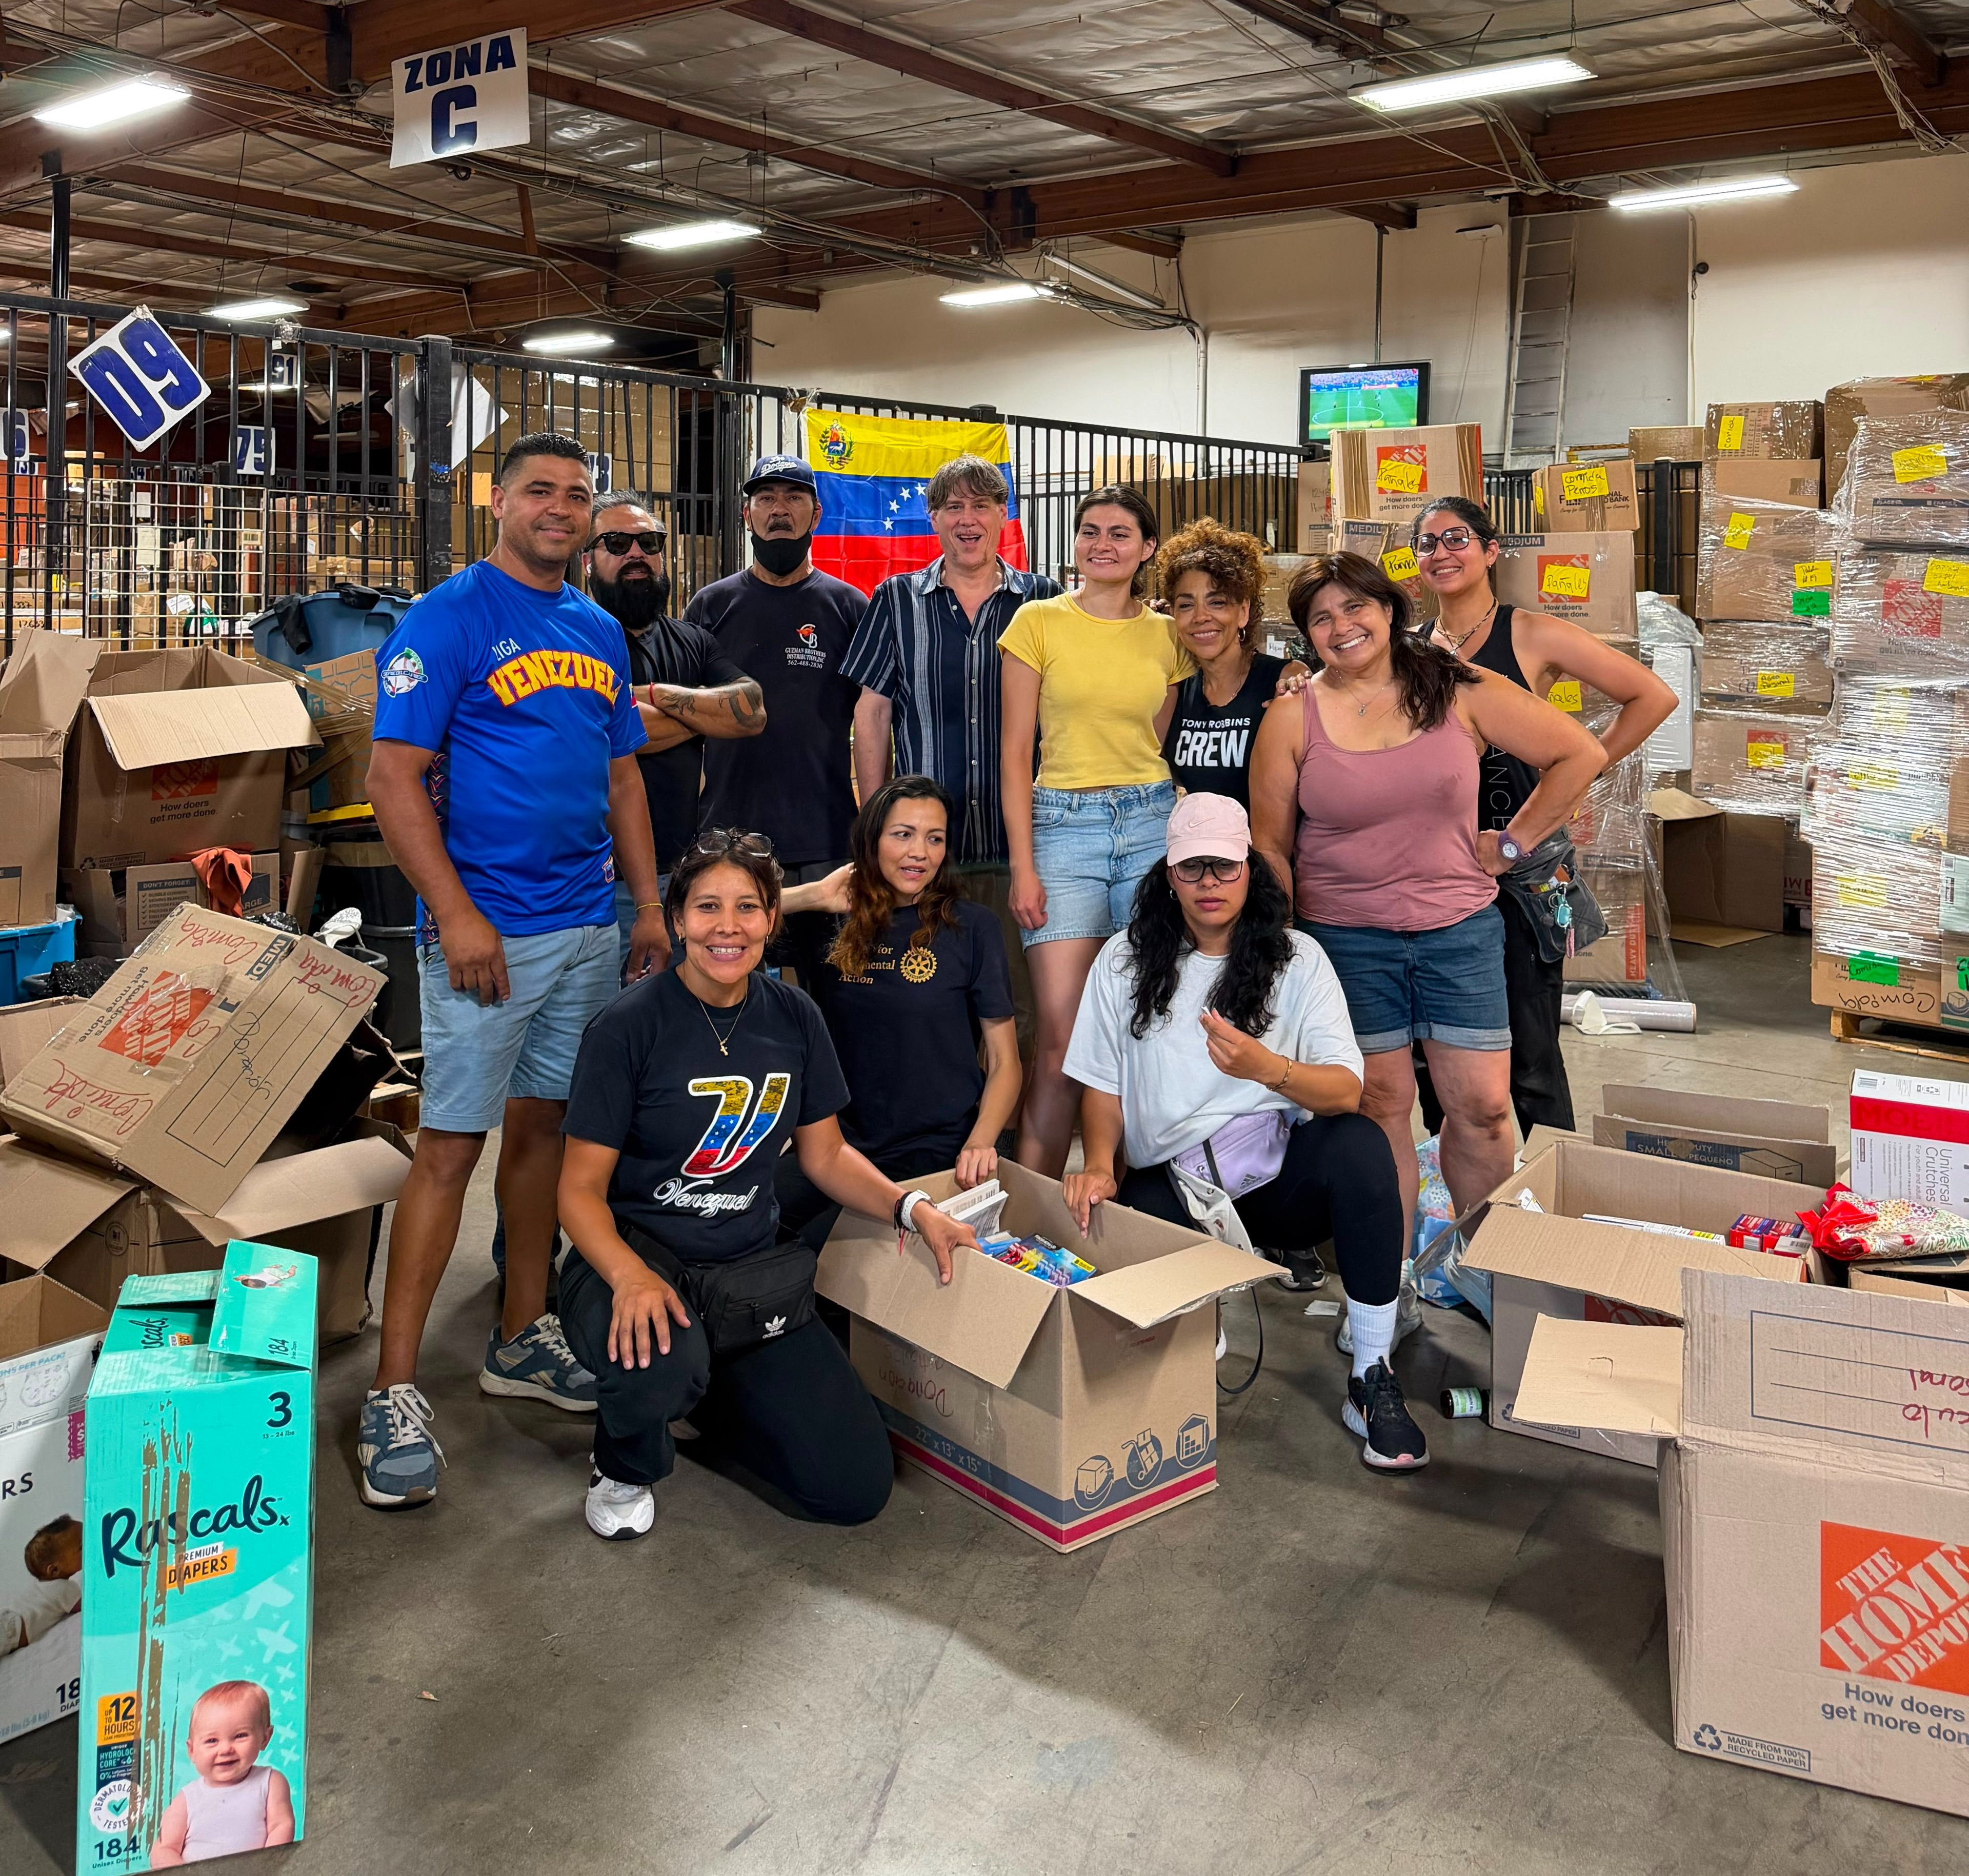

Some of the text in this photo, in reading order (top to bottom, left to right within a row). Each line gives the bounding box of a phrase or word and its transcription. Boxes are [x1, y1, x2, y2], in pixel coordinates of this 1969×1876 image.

[404, 36, 516, 94] ZONA
[431, 85, 478, 155] C
[82, 317, 202, 442] 09
[761, 461, 798, 474] Dodgers
[805, 648, 826, 658] BROTHERS
[487, 650, 622, 708] VENEZUEL
[1182, 718, 1251, 729] TONY ROBBINS
[1174, 730, 1250, 768] CREW
[149, 813, 166, 824] get
[168, 806, 192, 820] more
[160, 800, 210, 812] How doers
[877, 943, 894, 955] for
[130, 966, 149, 986] get
[838, 974, 874, 984] Action
[94, 979, 149, 1037] How doers
[105, 985, 132, 1014] more
[1838, 992, 1935, 1013] Comida
[1689, 1153, 1734, 1166] PEQUEÑO
[1695, 1144, 1712, 1153] UTY
[1925, 1146, 1939, 1202] Crutches
[1940, 1148, 1953, 1206] Universal
[268, 1337, 289, 1356] 184
[266, 1391, 292, 1428] 3
[178, 1545, 219, 1563] PREMIUM
[168, 1555, 228, 1584] DIAPERS
[1835, 1546, 1903, 1601] THE
[60, 1699, 81, 1713] DIAP
[104, 1708, 112, 1717] UP
[109, 1696, 135, 1722] 12
[1844, 1682, 1965, 1723] How doers
[104, 1721, 135, 1736] HOURS
[1820, 1703, 1969, 1745] get more don
[99, 1748, 135, 1761] HYDROLOC
[1727, 1736, 1806, 1760] MADE FROM 100%
[1727, 1743, 1806, 1768] RECYCLED PAPER
[94, 1834, 140, 1861] 184
[92, 1860, 114, 1869] Unisex
